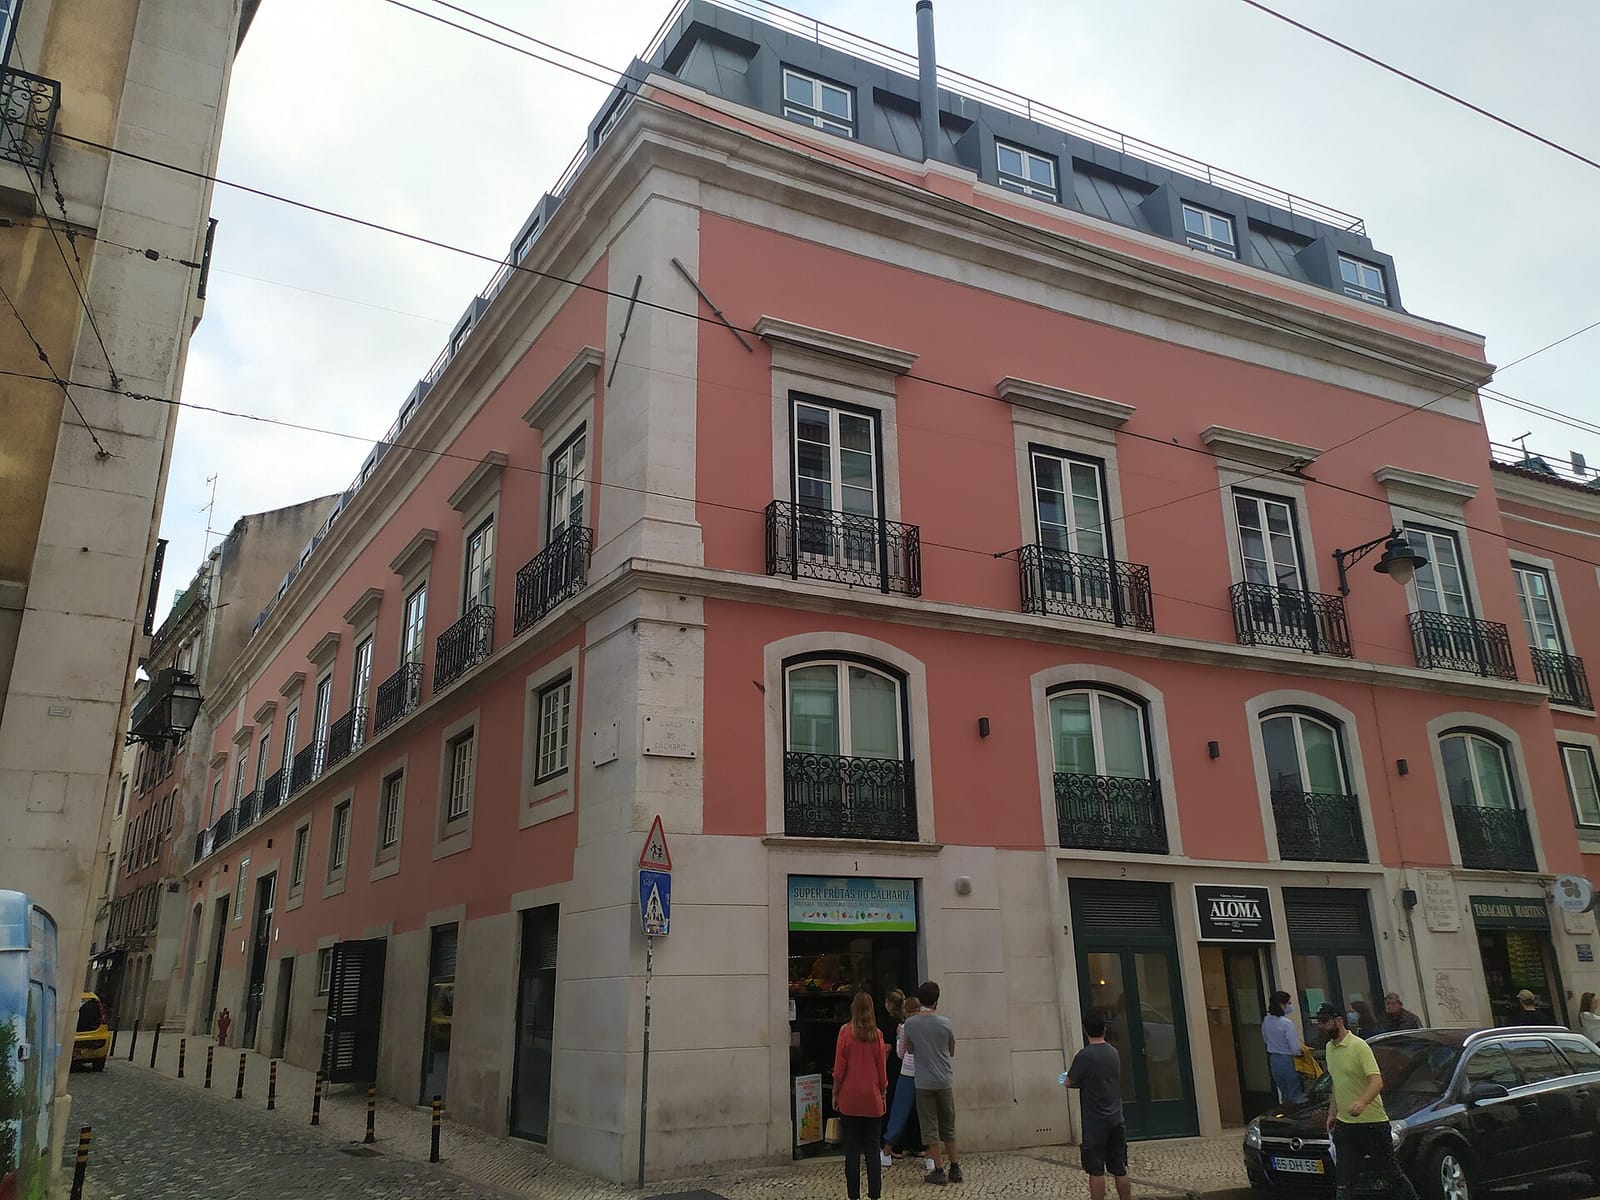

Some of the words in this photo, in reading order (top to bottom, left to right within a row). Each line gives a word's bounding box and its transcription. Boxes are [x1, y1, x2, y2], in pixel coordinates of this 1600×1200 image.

[853, 860, 860, 872] 1
[1119, 866, 1127, 877] 2
[793, 887, 822, 899] SUPER
[823, 887, 856, 900] FRUTAS
[857, 888, 869, 900] DO
[870, 888, 911, 900] CALHARIZ
[1210, 902, 1262, 918] ALOMA
[1473, 904, 1513, 918] TABACARIA
[1513, 904, 1546, 919] MARTINS
